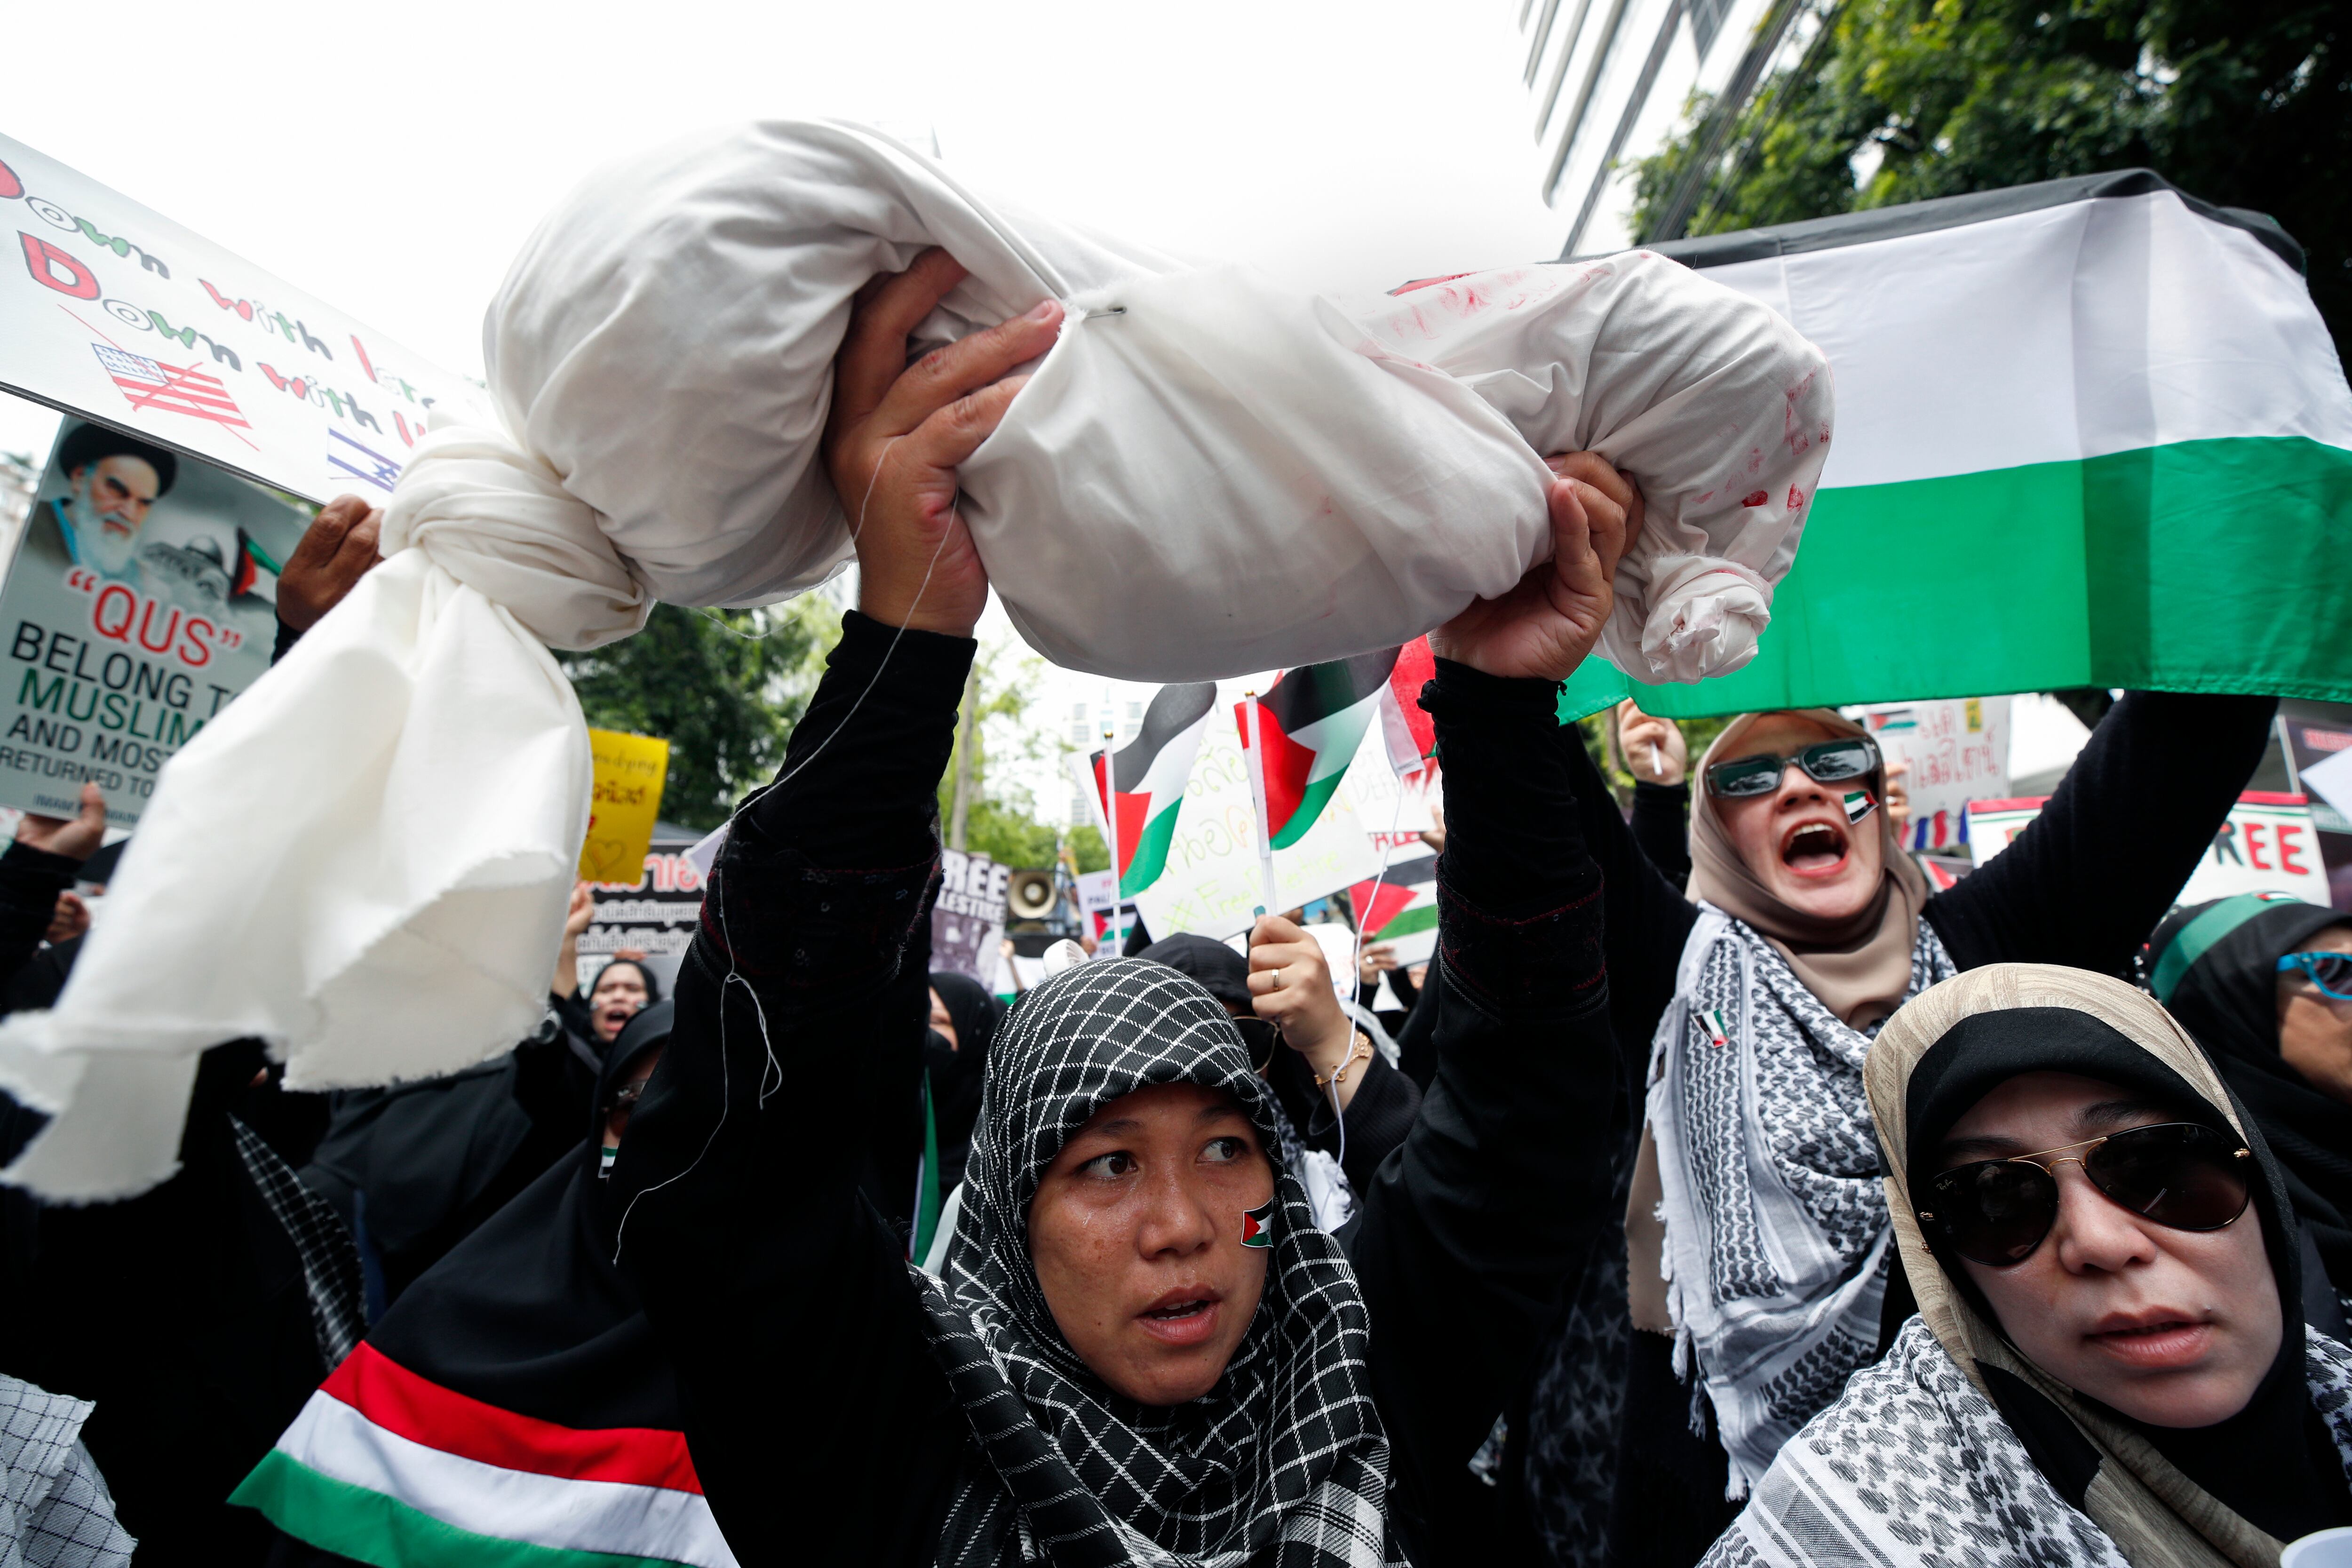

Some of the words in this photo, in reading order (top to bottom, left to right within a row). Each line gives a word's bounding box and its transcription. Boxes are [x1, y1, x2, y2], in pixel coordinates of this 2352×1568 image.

[17, 230, 242, 372] Down
[10, 621, 193, 709] BELONG
[207, 684, 242, 717] T
[6, 714, 82, 753] AND
[2212, 821, 2310, 876] REE
[941, 850, 1010, 903] REE
